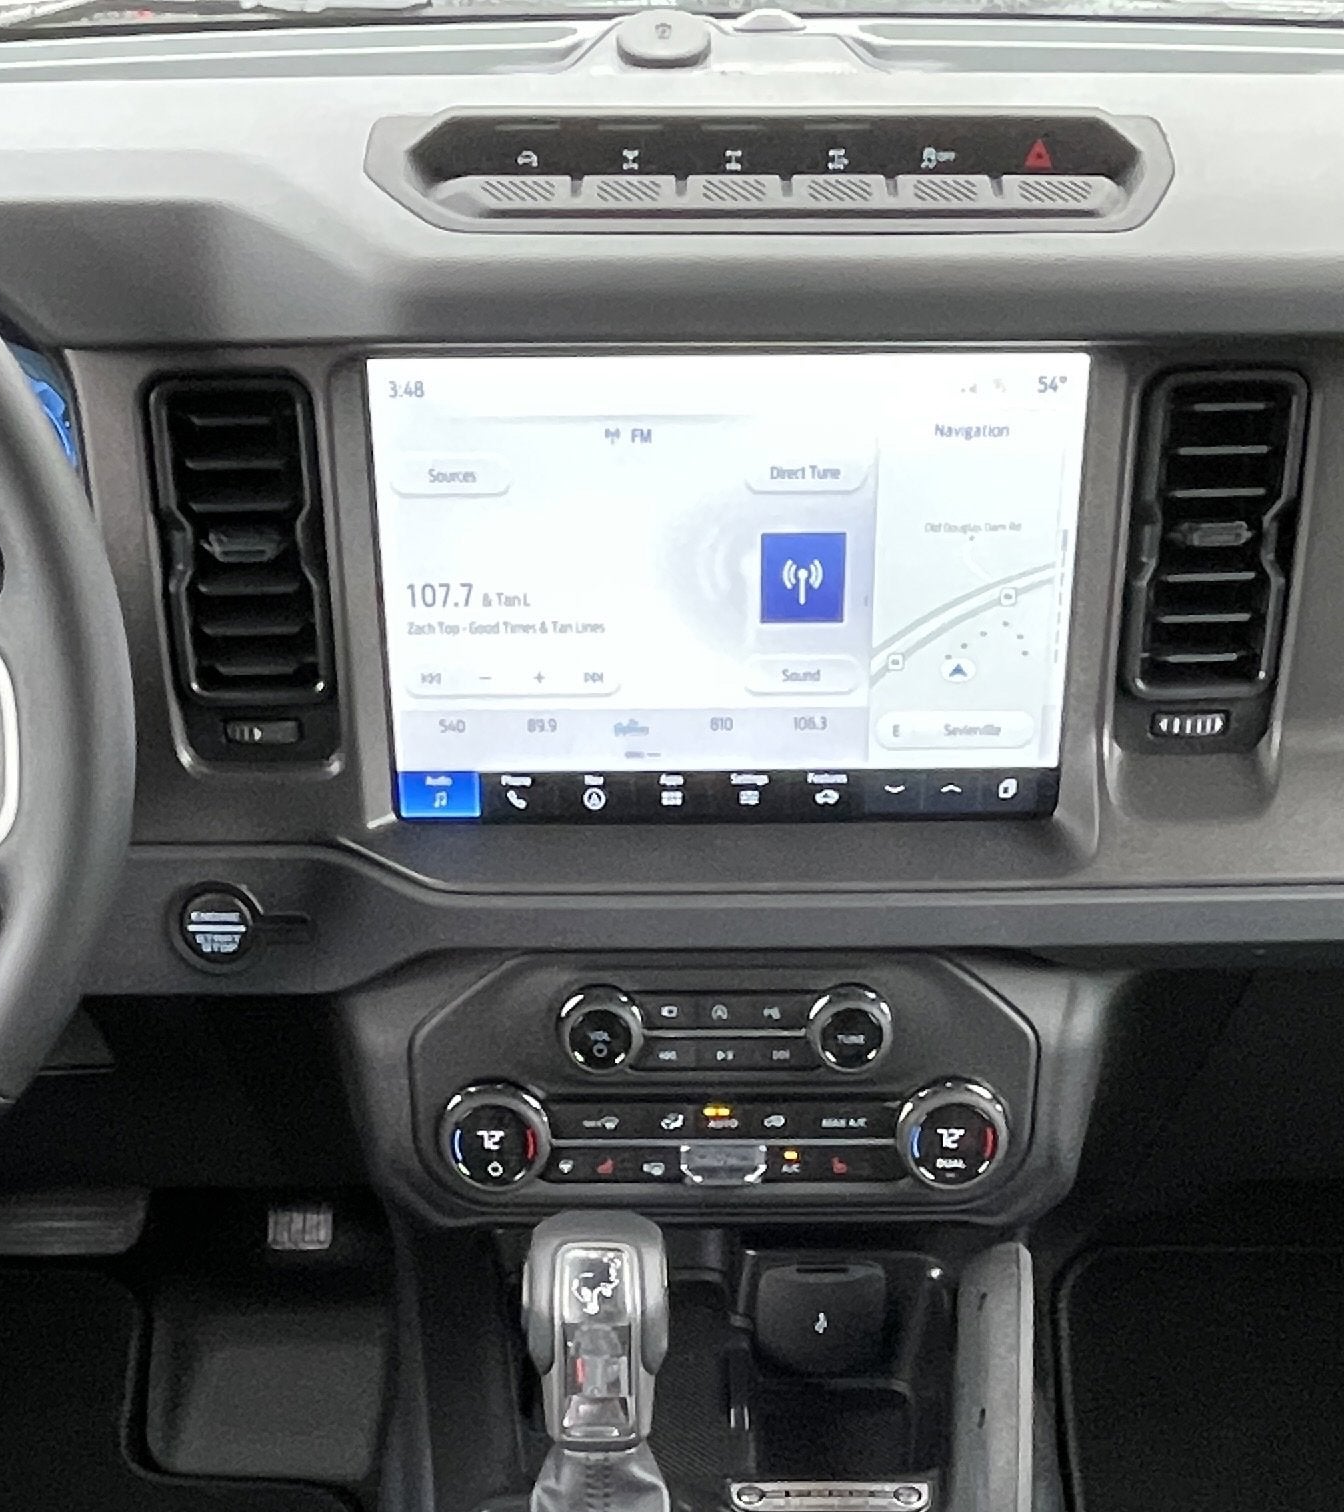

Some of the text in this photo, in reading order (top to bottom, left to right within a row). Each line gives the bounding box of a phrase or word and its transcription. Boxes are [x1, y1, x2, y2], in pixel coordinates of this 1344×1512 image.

[388, 380, 425, 399] 3:48
[631, 428, 653, 444] FM
[933, 423, 1010, 440] Navigation
[427, 468, 477, 484] Sources
[769, 464, 841, 480] Direct Tune
[405, 582, 474, 608] 107.7
[481, 592, 493, 608] &
[495, 592, 521, 608] Tan
[406, 621, 436, 636] Zach
[437, 620, 460, 637] Top
[468, 620, 500, 635] Good
[502, 620, 537, 635] Times
[538, 619, 549, 635] &
[551, 619, 574, 635] Tan
[574, 620, 606, 635] Lines
[781, 668, 822, 683] Sound
[438, 718, 467, 734] 540
[526, 717, 558, 733] 89.9
[475, 1129, 506, 1151] 72
[936, 1127, 966, 1150] 72
